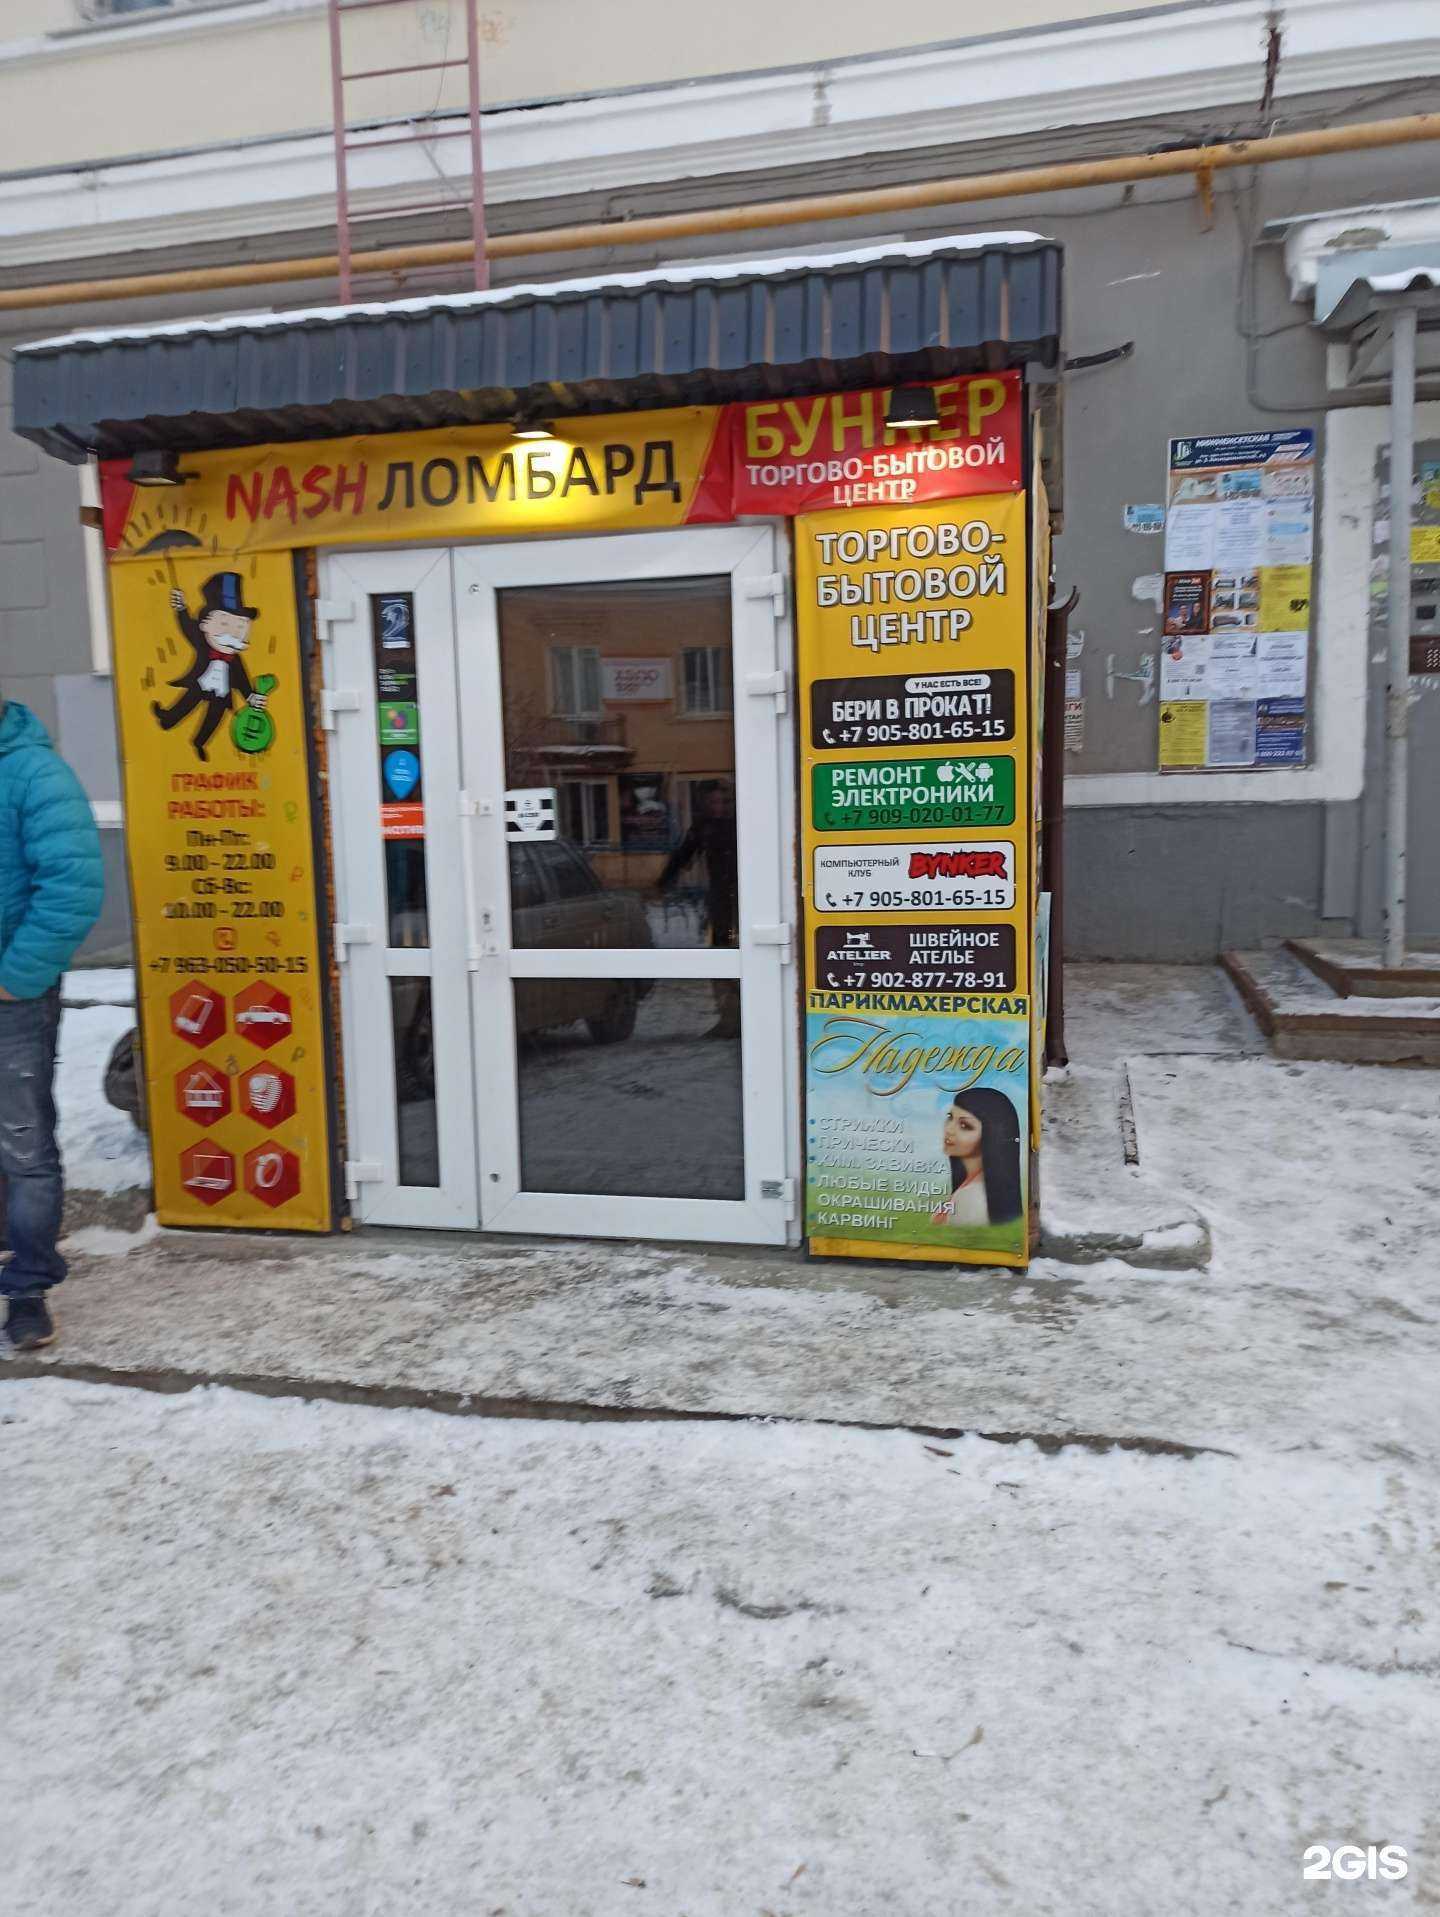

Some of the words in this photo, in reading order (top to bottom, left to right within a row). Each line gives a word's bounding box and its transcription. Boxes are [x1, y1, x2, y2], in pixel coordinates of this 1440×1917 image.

[746, 436, 1005, 486] ТОРГОВО-БЫТОВОЙ
[225, 461, 368, 525] NASH
[377, 440, 682, 511] ЛОМБАРД
[833, 478, 917, 506] ЦЕНТР
[816, 521, 1005, 565] ТОРГОВО-
[816, 554, 1005, 608] БЫТОВОЙ
[851, 609, 972, 652] ЦЕНТР
[921, 681, 939, 689] НАС
[940, 680, 961, 688] ЕСТЬ
[963, 678, 982, 687] ВСЕ!
[832, 700, 881, 722] БЕРИ
[886, 699, 899, 719] В
[904, 694, 992, 719] ПРОКАТ!
[840, 726, 863, 743] +7
[867, 719, 1005, 742] 905-801-65-15
[171, 772, 259, 792] ГРАФИК
[832, 765, 925, 787] РЕМОНТ
[832, 784, 994, 807] ЭЛЕКТРОНИКИ
[842, 810, 863, 825] +7
[869, 805, 1005, 825] 909-020-01-77
[820, 857, 900, 868] КОМПЬЮТЕРНЫЙ
[848, 869, 872, 878] КЛУБ
[843, 892, 863, 907] +7
[870, 889, 1005, 907] 905-801-65-15
[909, 929, 999, 947] ШВЕЙНОЕ
[827, 950, 892, 960] ATELIER
[909, 950, 975, 965] АТЕЛЬЕ
[844, 973, 866, 988] +7
[871, 972, 1006, 988] 902-877-78-91
[810, 992, 1027, 1015] ПАРИКМАХЕРСКАЯ
[809, 1017, 1025, 1097] Надежда
[865, 1158, 950, 1174] ЗАВИВКА
[817, 1175, 888, 1192] ЛЮБЫЕ
[893, 1179, 947, 1197] ВИДЫ
[818, 1193, 955, 1215] ОКРАШИВАНИЯ
[818, 1211, 899, 1229] КАРВИНГ
